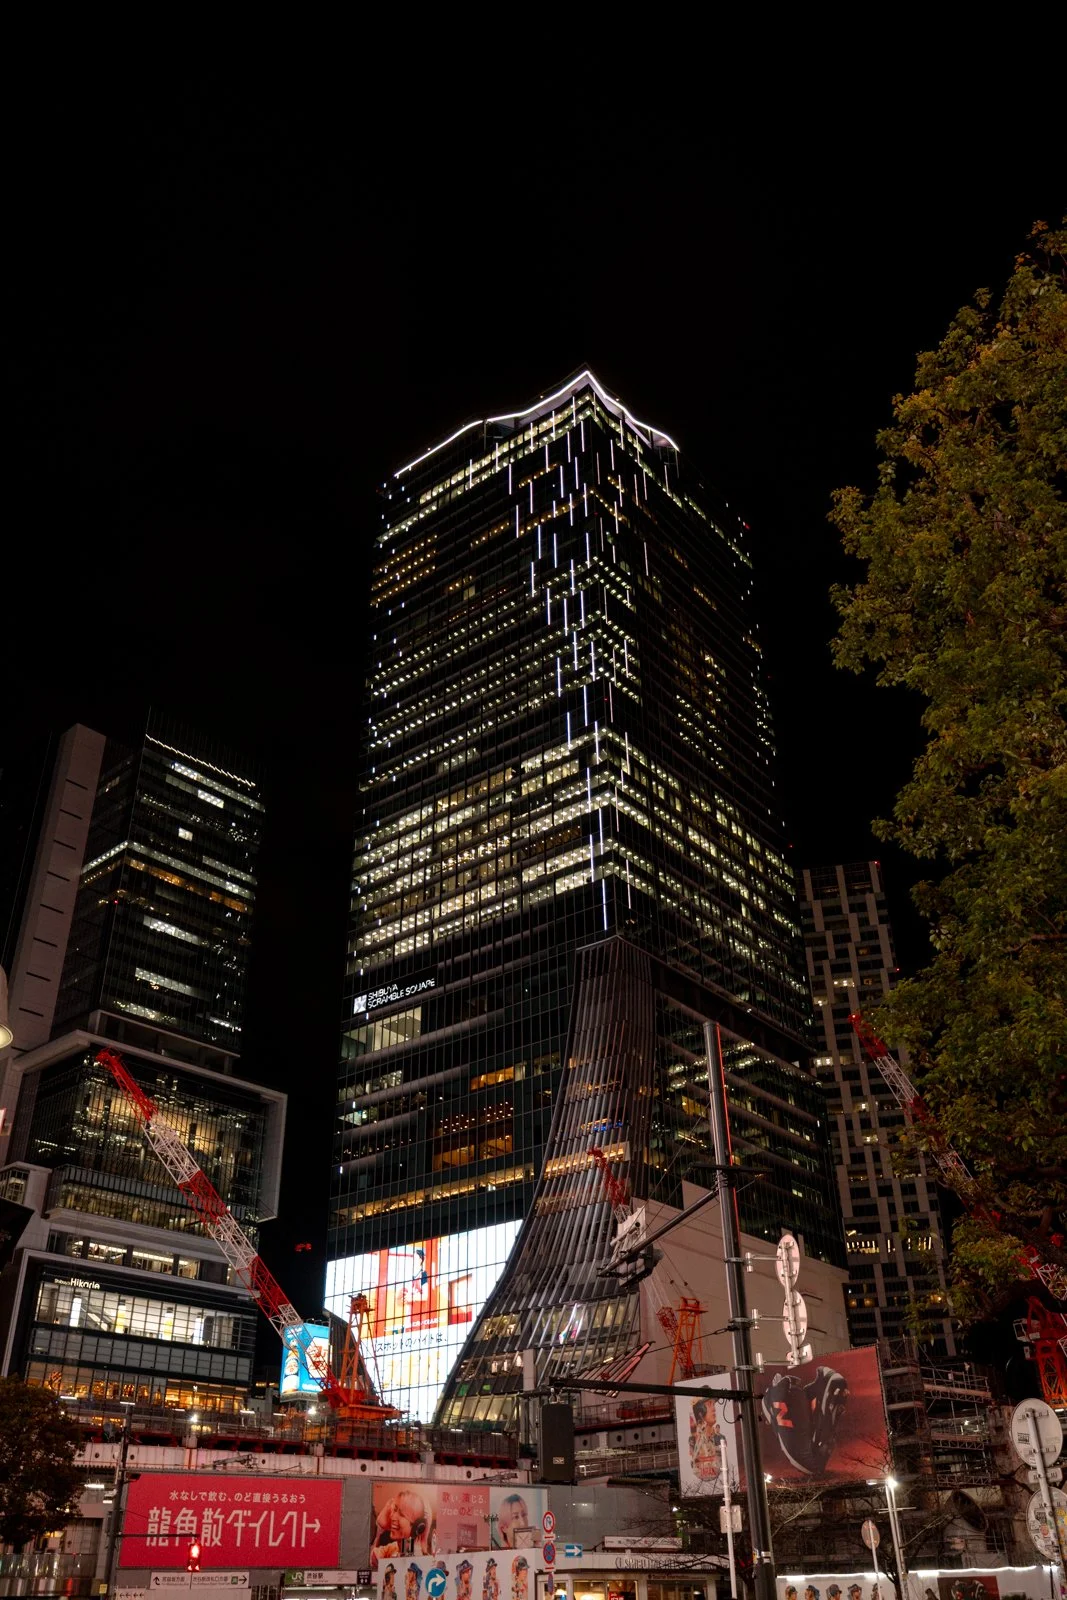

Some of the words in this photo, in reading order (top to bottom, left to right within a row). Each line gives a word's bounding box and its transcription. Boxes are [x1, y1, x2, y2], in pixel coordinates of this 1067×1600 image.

[367, 991, 405, 1008] SCRAMBLE
[405, 979, 436, 995] SQUARE
[368, 984, 398, 1001] SHIBUYA
[71, 1278, 101, 1290] Hikarie
[168, 1489, 307, 1504] 水なしで飲む、のど直接うるおう
[145, 1506, 321, 1548] 龍角散ダイレクト
[291, 1571, 303, 1580] JR
